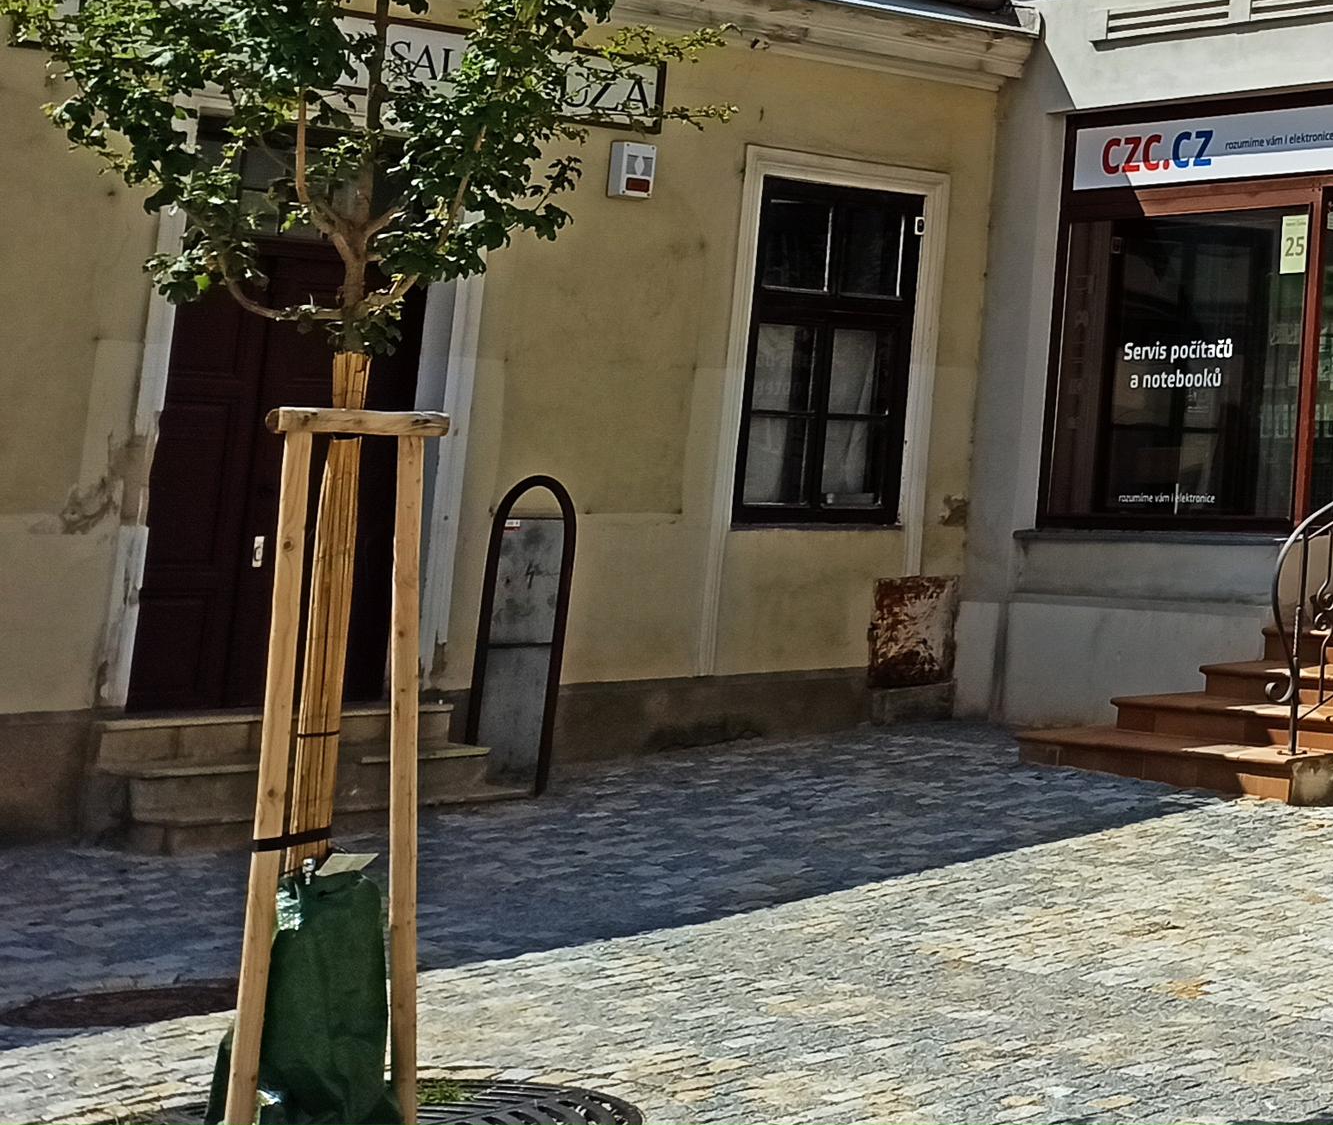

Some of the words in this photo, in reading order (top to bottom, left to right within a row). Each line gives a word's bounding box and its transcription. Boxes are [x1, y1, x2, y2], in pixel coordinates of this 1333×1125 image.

[1102, 129, 1214, 174] CZC.CZ
[1285, 236, 1305, 257] 25
[1123, 341, 1167, 361] Servis
[1170, 338, 1233, 363] počítačů
[1130, 374, 1139, 388] a
[1142, 368, 1222, 388] notebooků
[1154, 492, 1170, 503] vám
